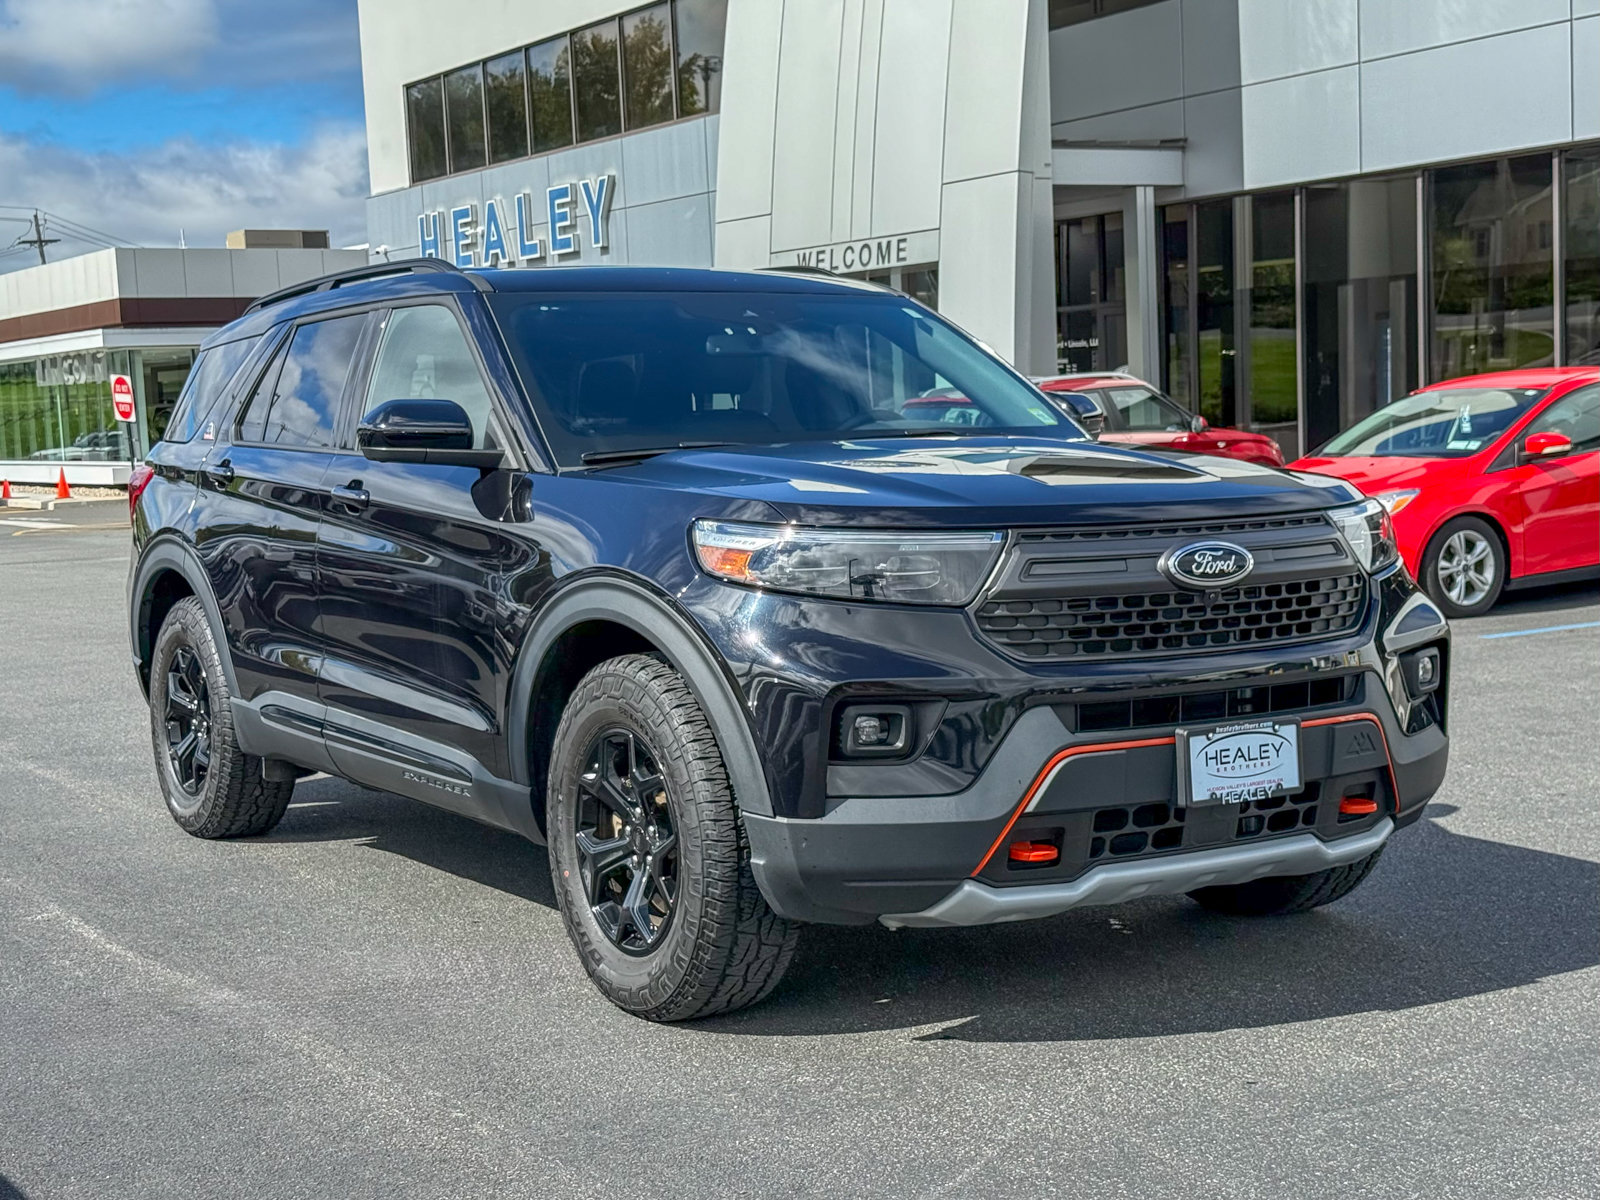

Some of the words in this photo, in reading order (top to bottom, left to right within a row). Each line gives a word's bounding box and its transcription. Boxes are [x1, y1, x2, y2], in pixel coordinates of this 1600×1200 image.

[418, 174, 615, 268] HEALEY
[797, 238, 908, 271] WELCOME
[115, 384, 121, 392] DO
[121, 384, 129, 393] NOT
[119, 404, 130, 412] ENTER
[1192, 550, 1237, 575] Ford
[1205, 742, 1284, 766] HEALEY
[1217, 761, 1270, 772] BROTHERS
[403, 770, 471, 797] EXPLORER
[1221, 785, 1273, 804] HEALEY
